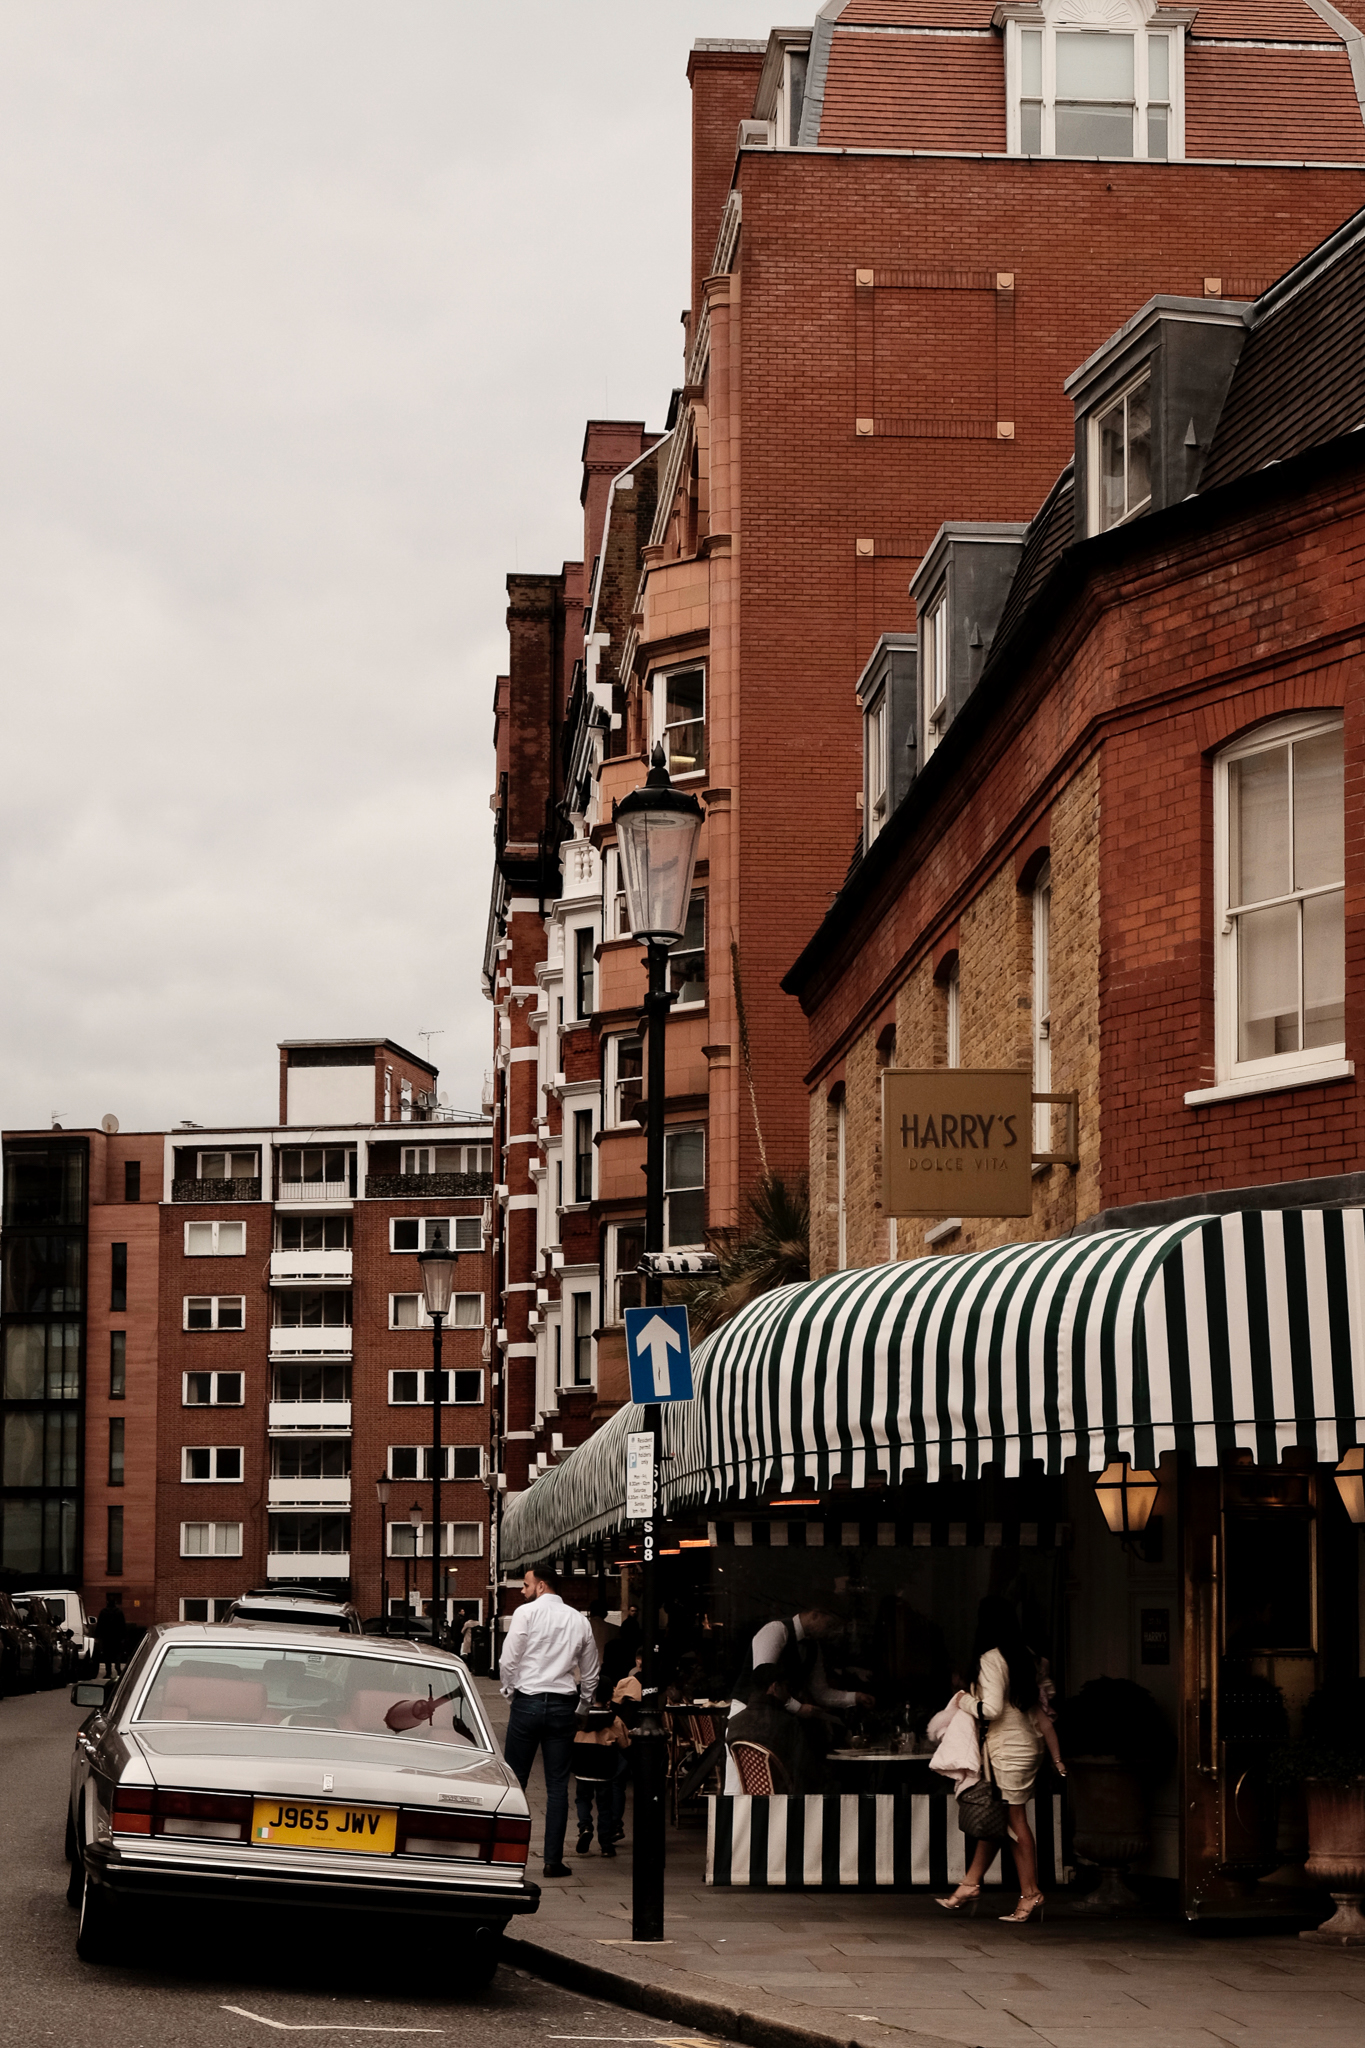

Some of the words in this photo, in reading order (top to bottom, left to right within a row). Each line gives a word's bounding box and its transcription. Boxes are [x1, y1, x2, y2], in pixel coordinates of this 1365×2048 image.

[900, 1113, 1018, 1149] HARRY'S
[908, 1157, 964, 1172] DOLCE
[974, 1157, 1009, 1172] VITA
[269, 1806, 329, 1831] J965
[335, 1811, 381, 1835] JWV
